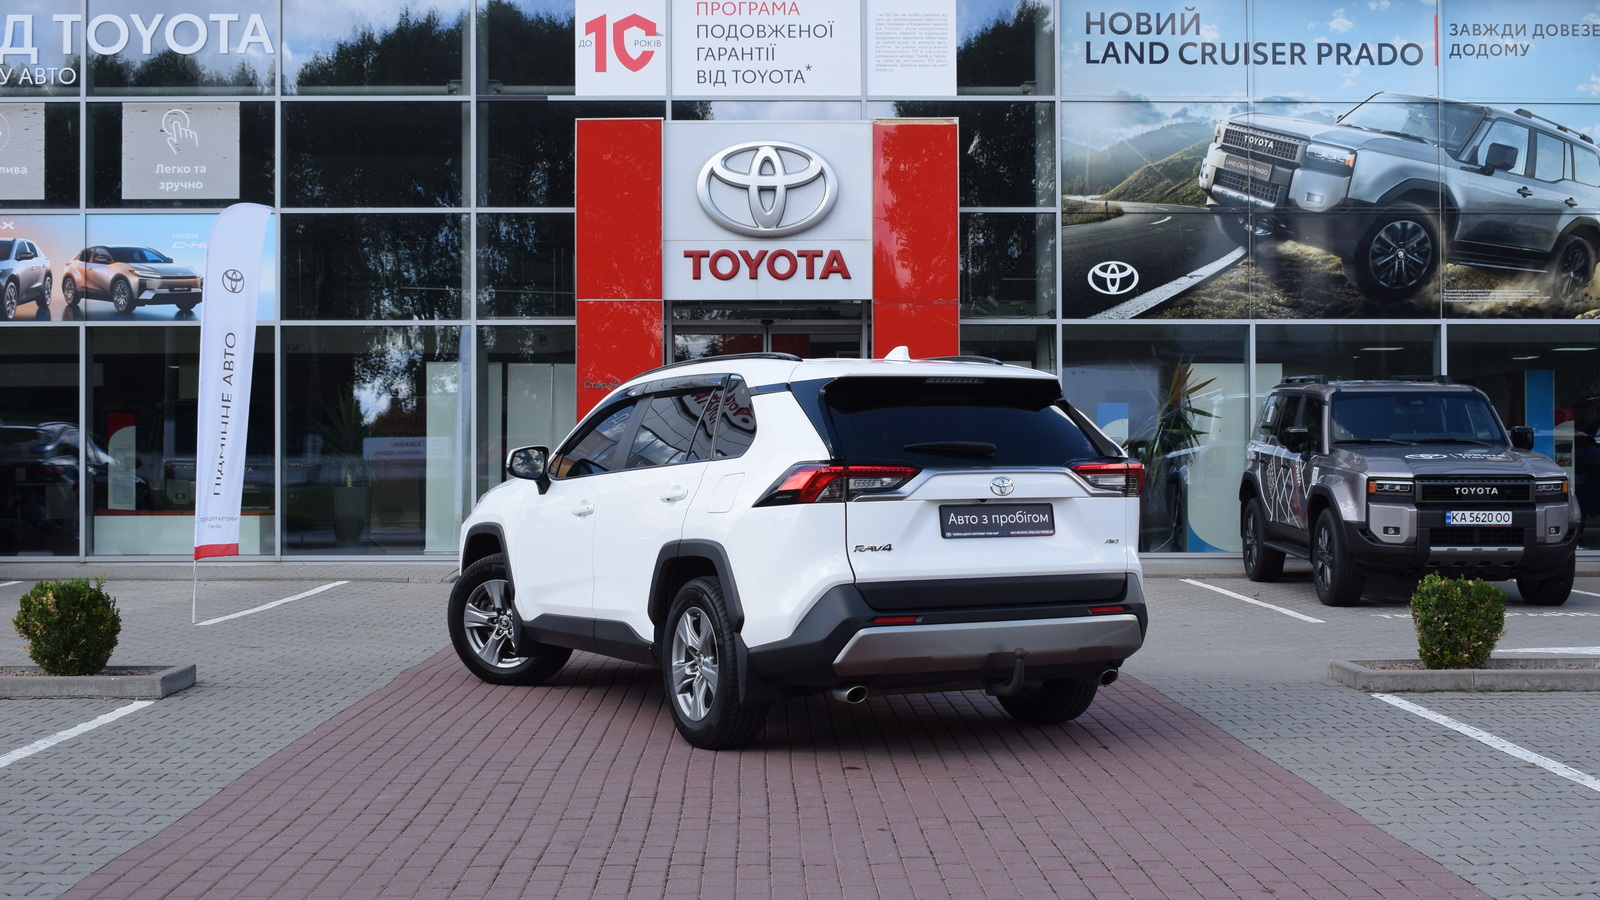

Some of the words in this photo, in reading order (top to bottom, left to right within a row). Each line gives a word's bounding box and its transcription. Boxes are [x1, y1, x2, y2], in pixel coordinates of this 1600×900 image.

[696, 2, 799, 16] ПРОГРАМА
[1085, 6, 1201, 36] НОВИЙ
[53, 13, 275, 56] TOYOTA
[696, 20, 834, 39] ПОДОВЖЕНОЇ
[1449, 23, 1527, 39] ЗАВЖДИ
[1532, 23, 1600, 39] ДОВЕЗЕ
[578, 39, 593, 49] ДО
[634, 39, 662, 48] РОКІВ
[696, 43, 776, 61] ГАРАНТІЇ
[1449, 43, 1530, 59] ДОДОМУ
[1085, 41, 1169, 66] LAND
[1178, 41, 1307, 66] CRUISER
[1317, 41, 1424, 66] PRADO
[19, 67, 77, 85] АВТО
[696, 69, 727, 86] ВІД
[1244, 135, 1274, 149] TOYOTA
[155, 164, 191, 175] Легко
[194, 166, 207, 174] та
[159, 181, 204, 192] зручно
[683, 249, 852, 280] TOYOTA
[223, 332, 237, 386] АВТО
[1454, 487, 1499, 495] TOYOTA
[948, 513, 979, 525] Авто
[981, 514, 989, 524] з
[992, 511, 1050, 527] пробігом
[1469, 512, 1494, 523] 5620
[853, 543, 893, 553] RAV4
